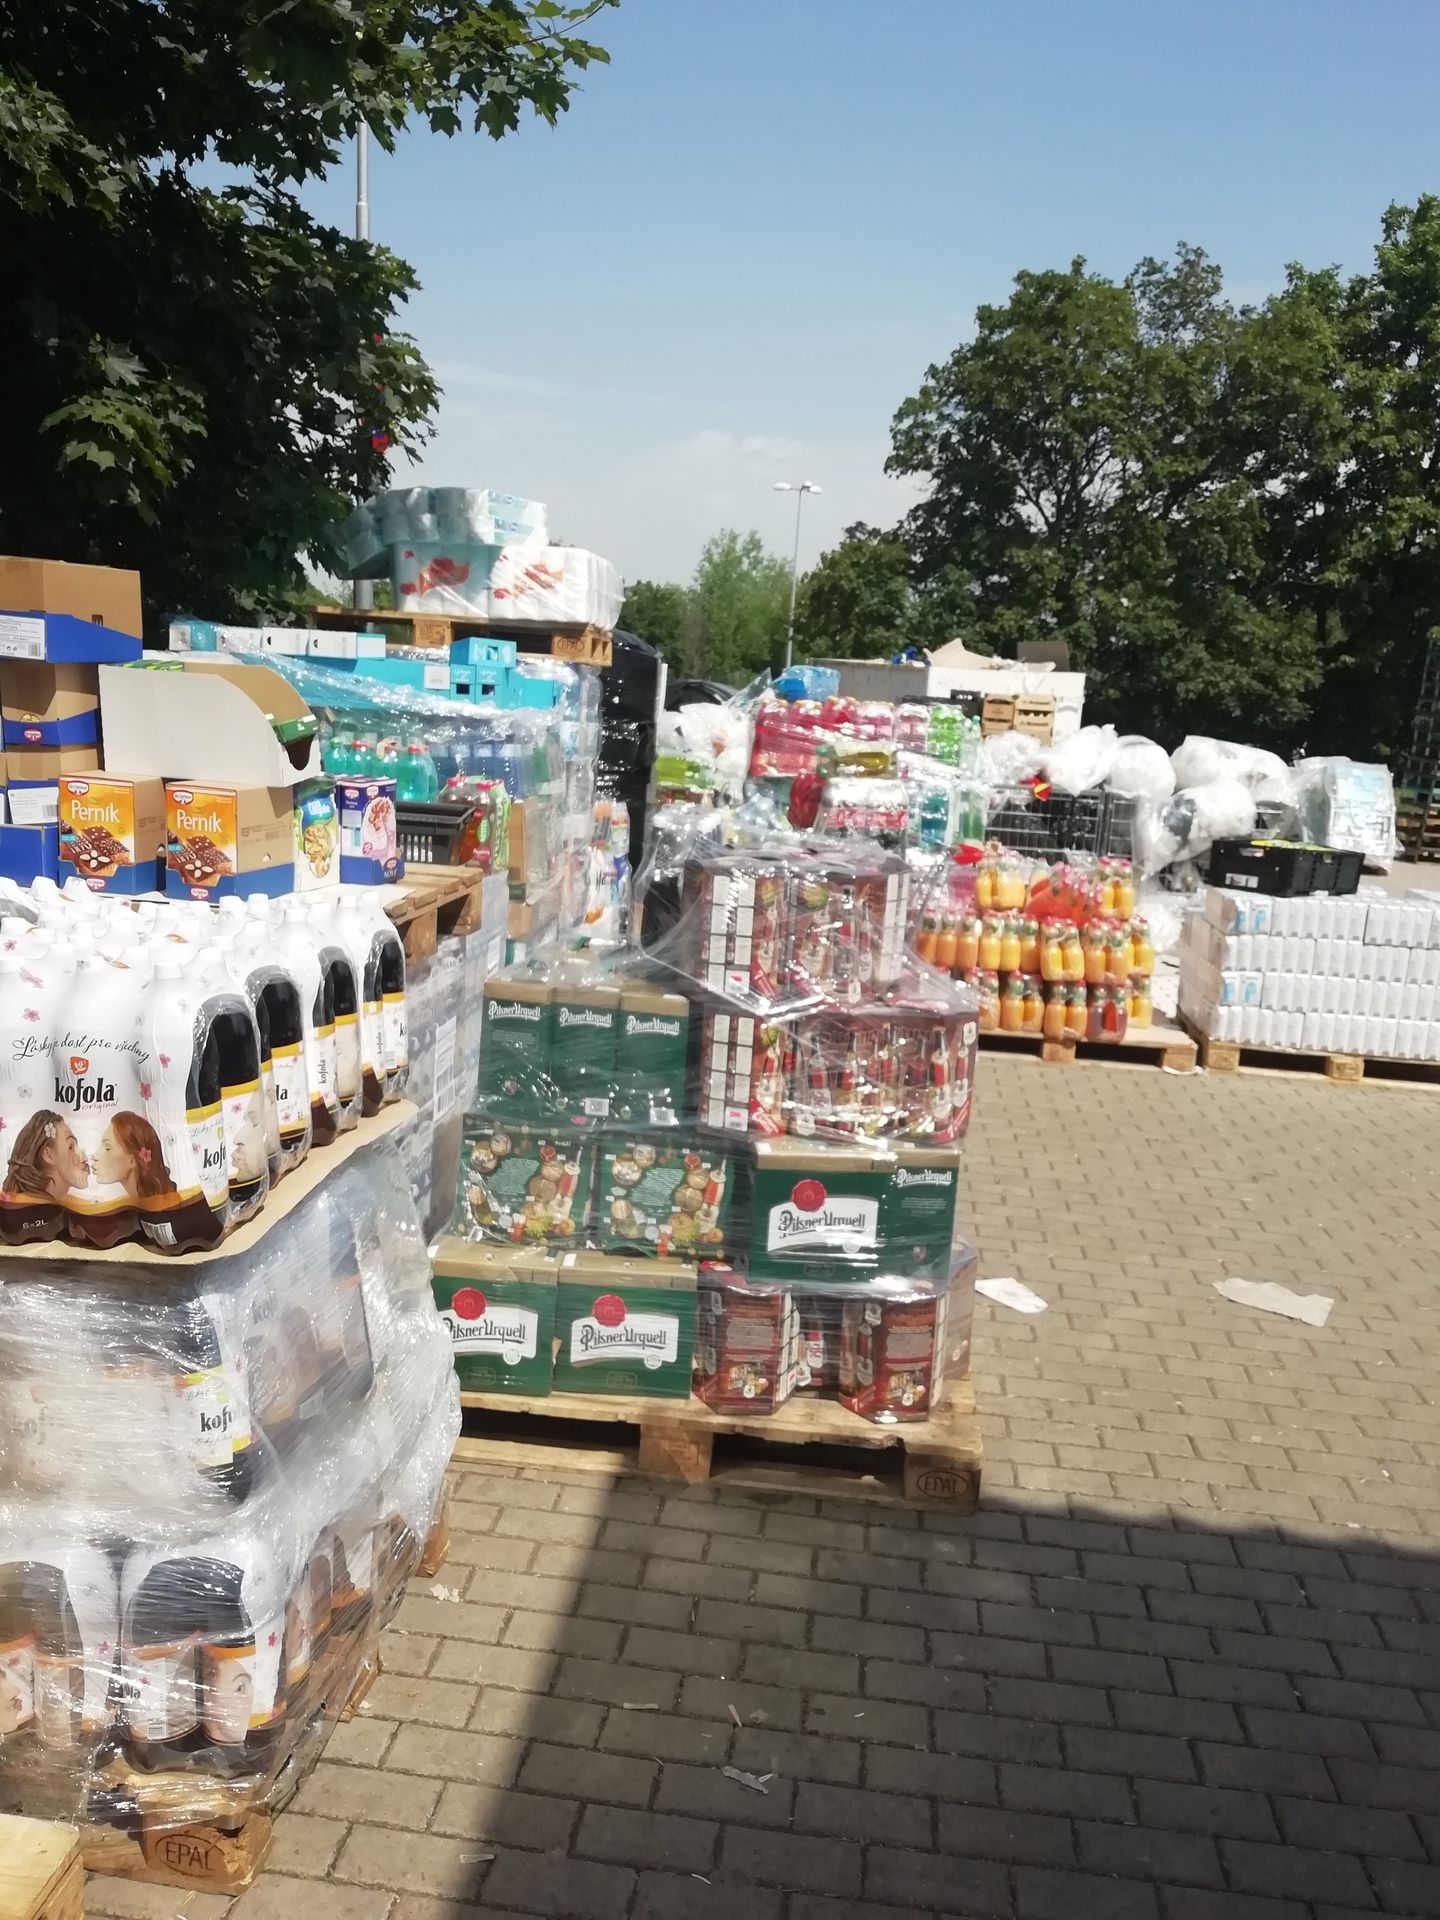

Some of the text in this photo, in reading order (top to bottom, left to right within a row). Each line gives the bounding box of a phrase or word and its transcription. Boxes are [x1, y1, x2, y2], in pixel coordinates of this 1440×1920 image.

[71, 800, 120, 823] Perník
[176, 809, 222, 832] Perník
[318, 1059, 328, 1084] kofola
[54, 1077, 115, 1112] kofola
[778, 1210, 824, 1239] Pilsner
[484, 1319, 526, 1344] Urquell
[580, 1324, 666, 1352] Pilsner Urquell
[166, 1841, 215, 1870] EPAL
